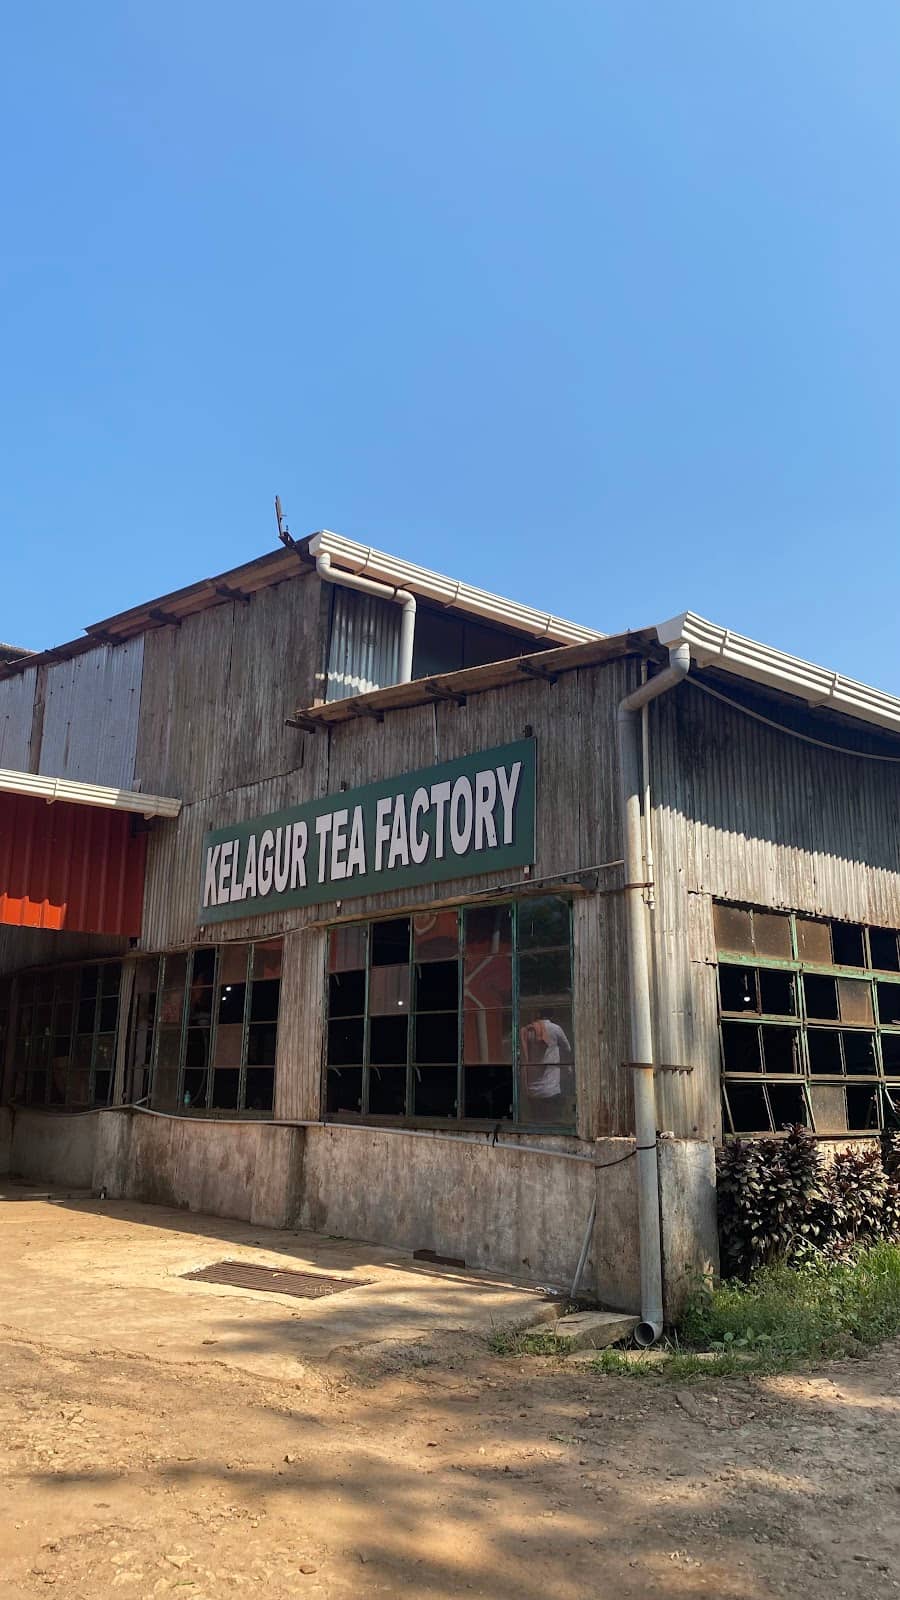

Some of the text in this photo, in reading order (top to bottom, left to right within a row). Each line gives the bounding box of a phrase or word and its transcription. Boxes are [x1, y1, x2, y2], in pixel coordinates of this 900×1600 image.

[203, 761, 522, 907] KELAGUR TEA FACTORY
